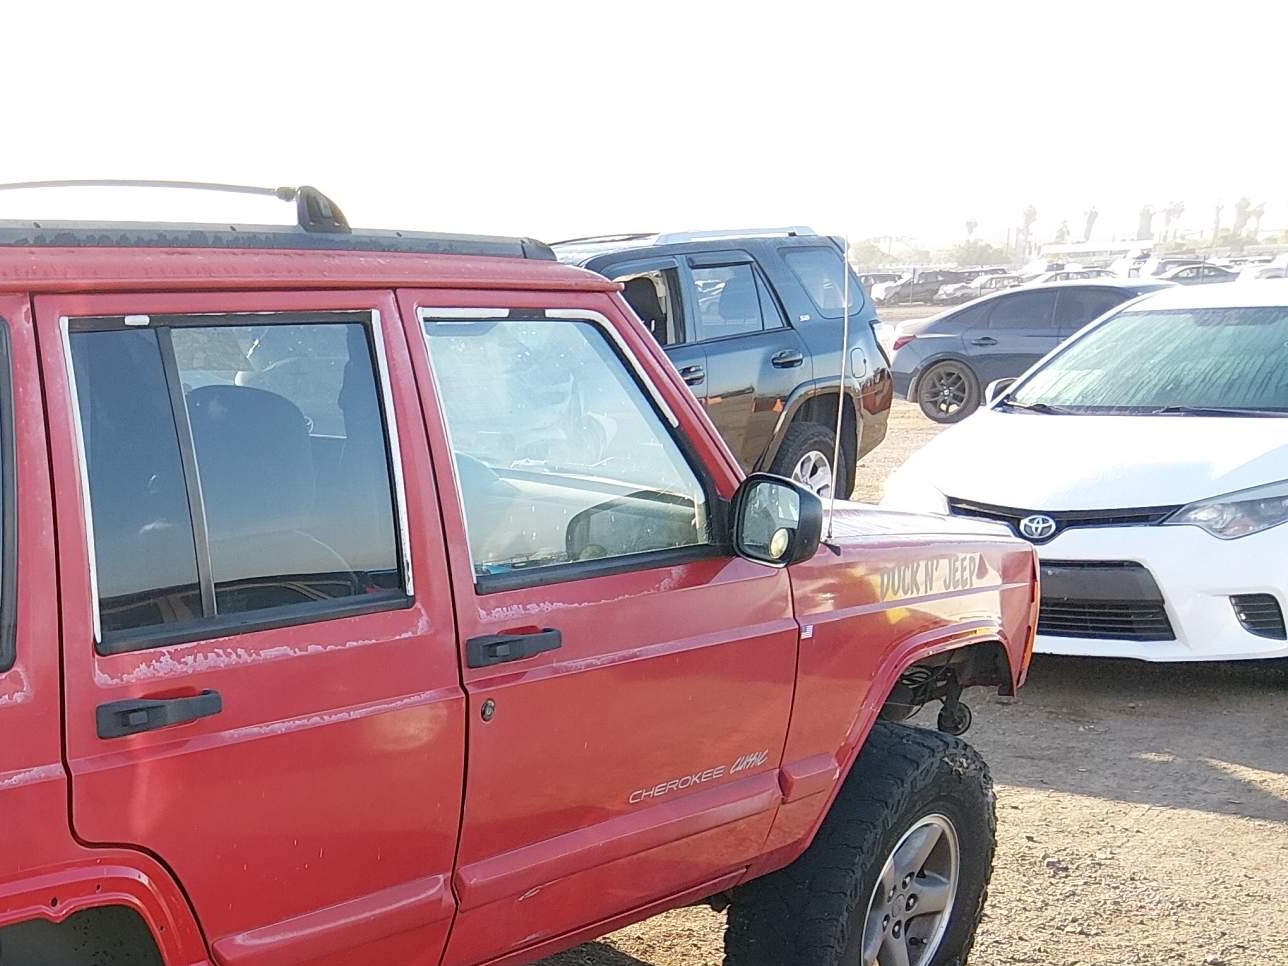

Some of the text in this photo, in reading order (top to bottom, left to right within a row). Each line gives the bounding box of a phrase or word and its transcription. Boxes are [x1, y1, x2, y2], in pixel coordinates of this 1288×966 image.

[880, 561, 920, 600] DUCK
[944, 555, 976, 591] JEEP
[629, 766, 727, 803] CHEROKEE
